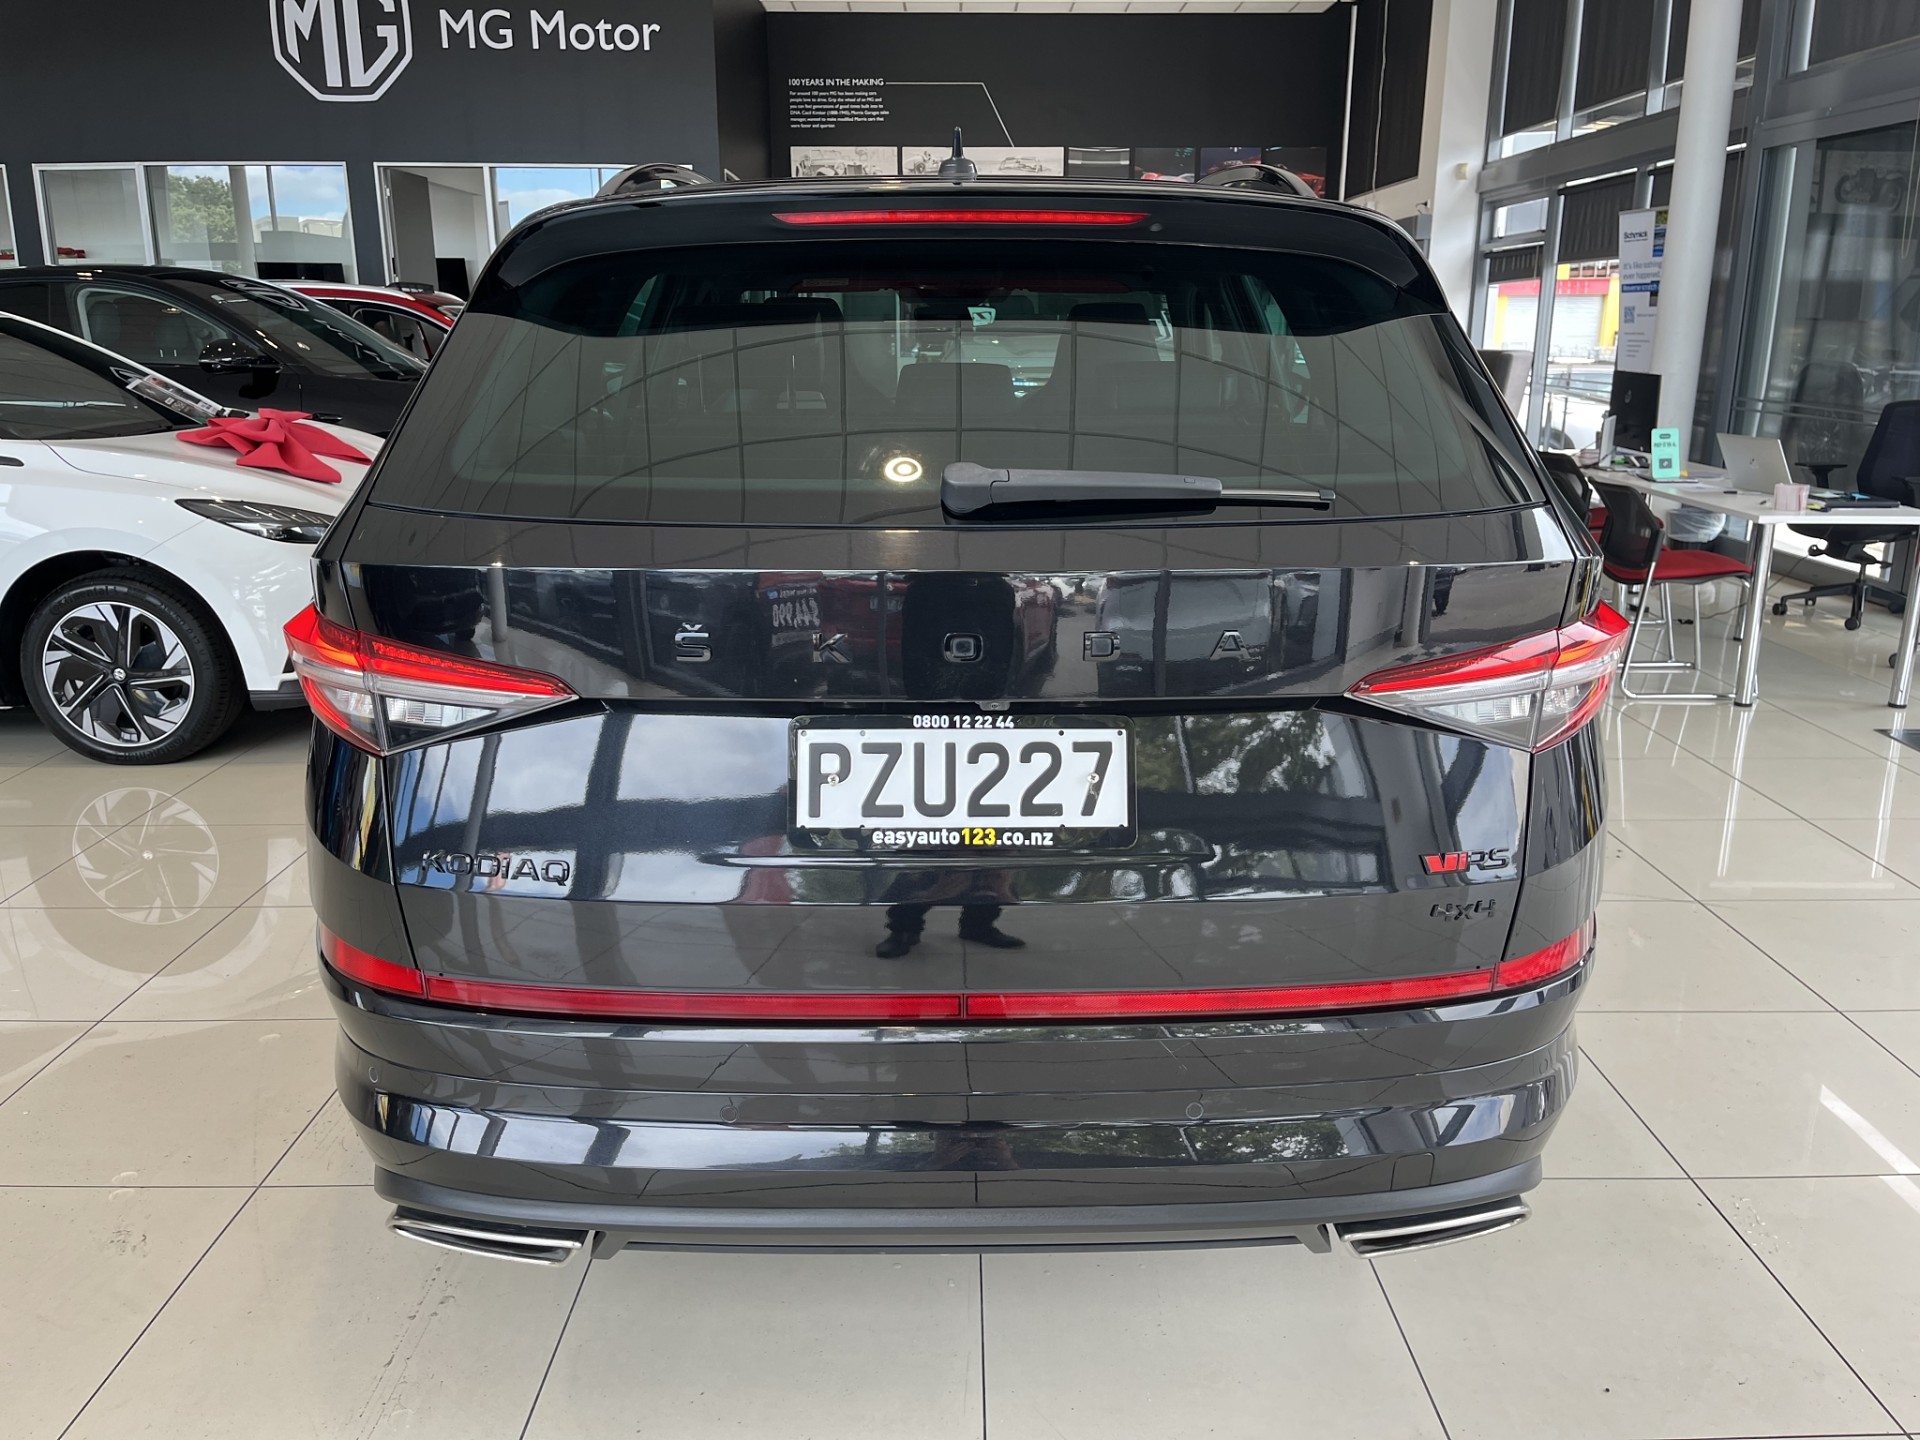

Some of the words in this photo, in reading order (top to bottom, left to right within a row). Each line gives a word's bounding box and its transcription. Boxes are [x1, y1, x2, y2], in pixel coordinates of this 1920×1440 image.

[438, 8, 514, 50] MG
[529, 9, 661, 51] Motor
[788, 78, 800, 86] 100
[801, 78, 824, 86] YEARS
[826, 78, 834, 86] IN
[836, 78, 850, 86] THE
[852, 78, 884, 86] MAKING
[673, 622, 1253, 663] ŠKODA
[913, 715, 950, 729] 0800
[953, 715, 971, 729] 12
[973, 715, 992, 729] 22
[995, 715, 1015, 729] 44
[808, 741, 1113, 818] PZU227
[872, 828, 1054, 850] easyauto123.co.nz
[421, 850, 571, 887] KODIAQ
